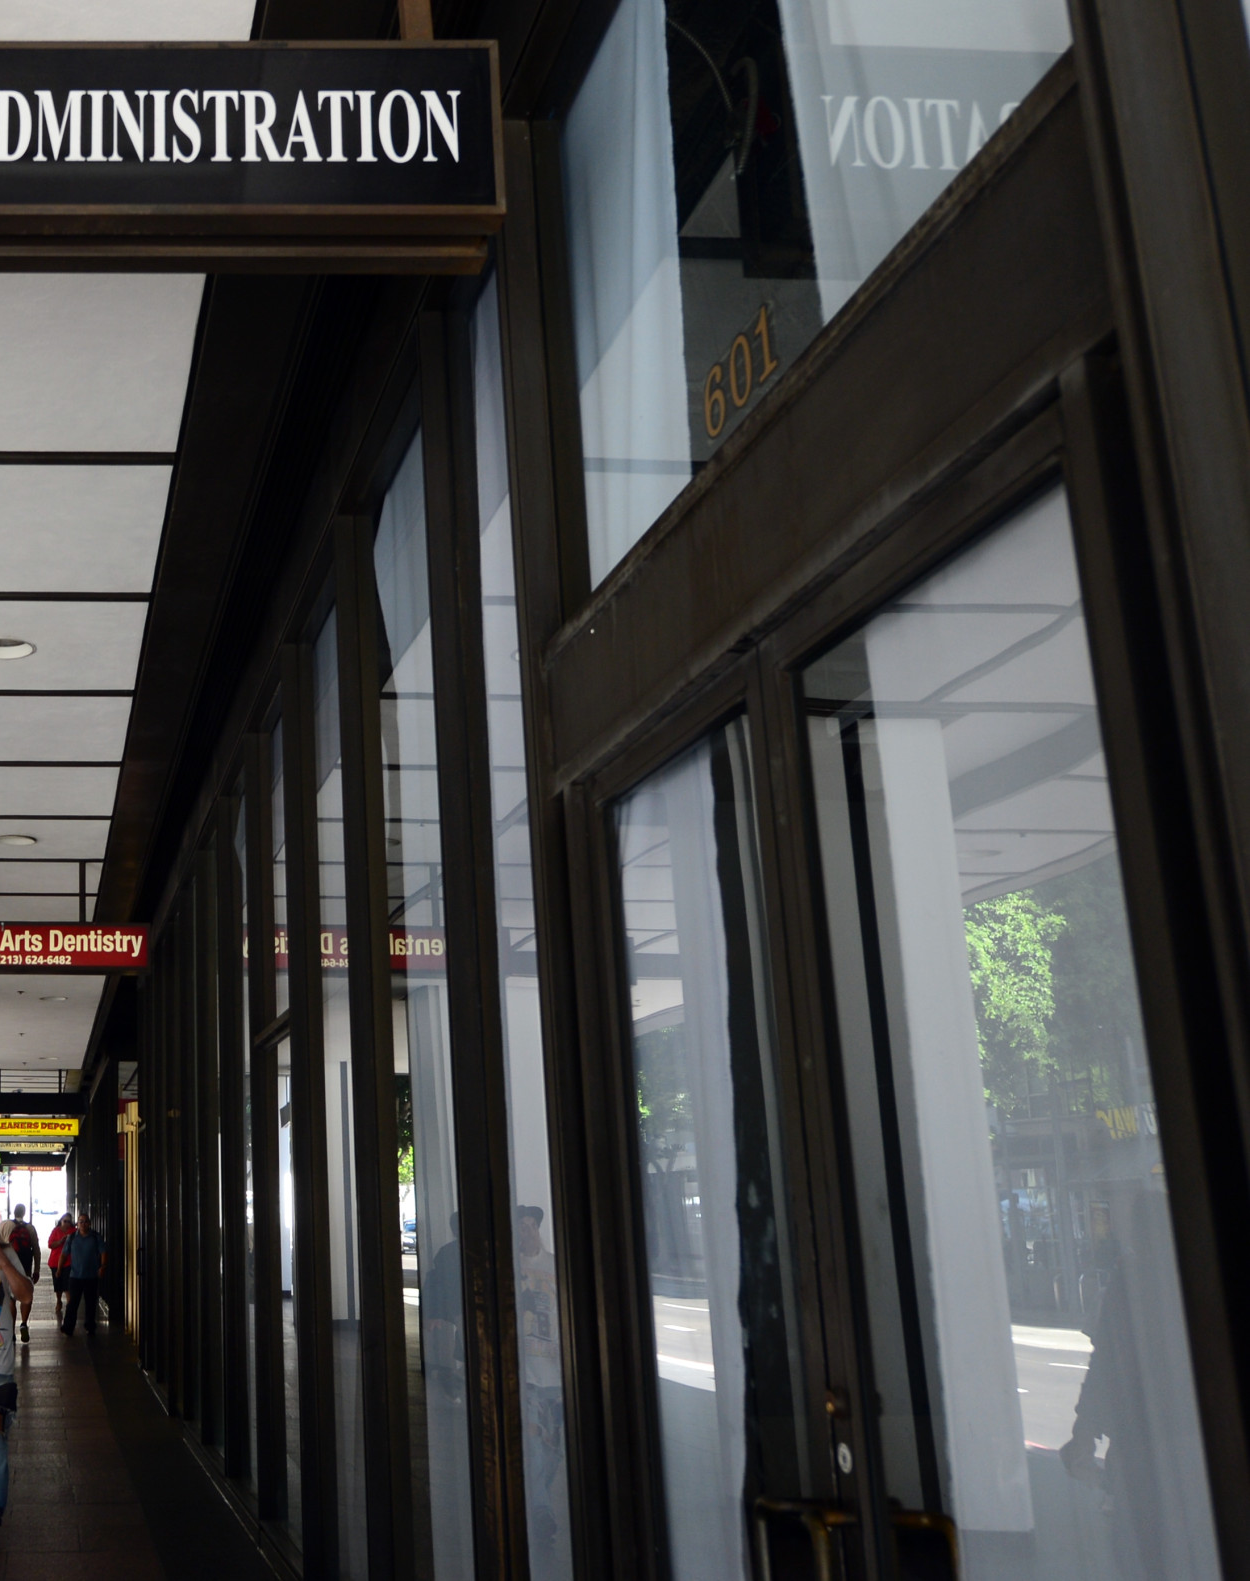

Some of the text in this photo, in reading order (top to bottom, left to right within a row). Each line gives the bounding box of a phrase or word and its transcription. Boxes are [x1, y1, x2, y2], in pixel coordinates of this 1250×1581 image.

[702, 304, 778, 439] 601
[0, 929, 43, 952] Arts
[49, 930, 143, 957] Dentistry
[25, 955, 72, 965] 624-6482
[40, 1123, 73, 1131] DEPOT
